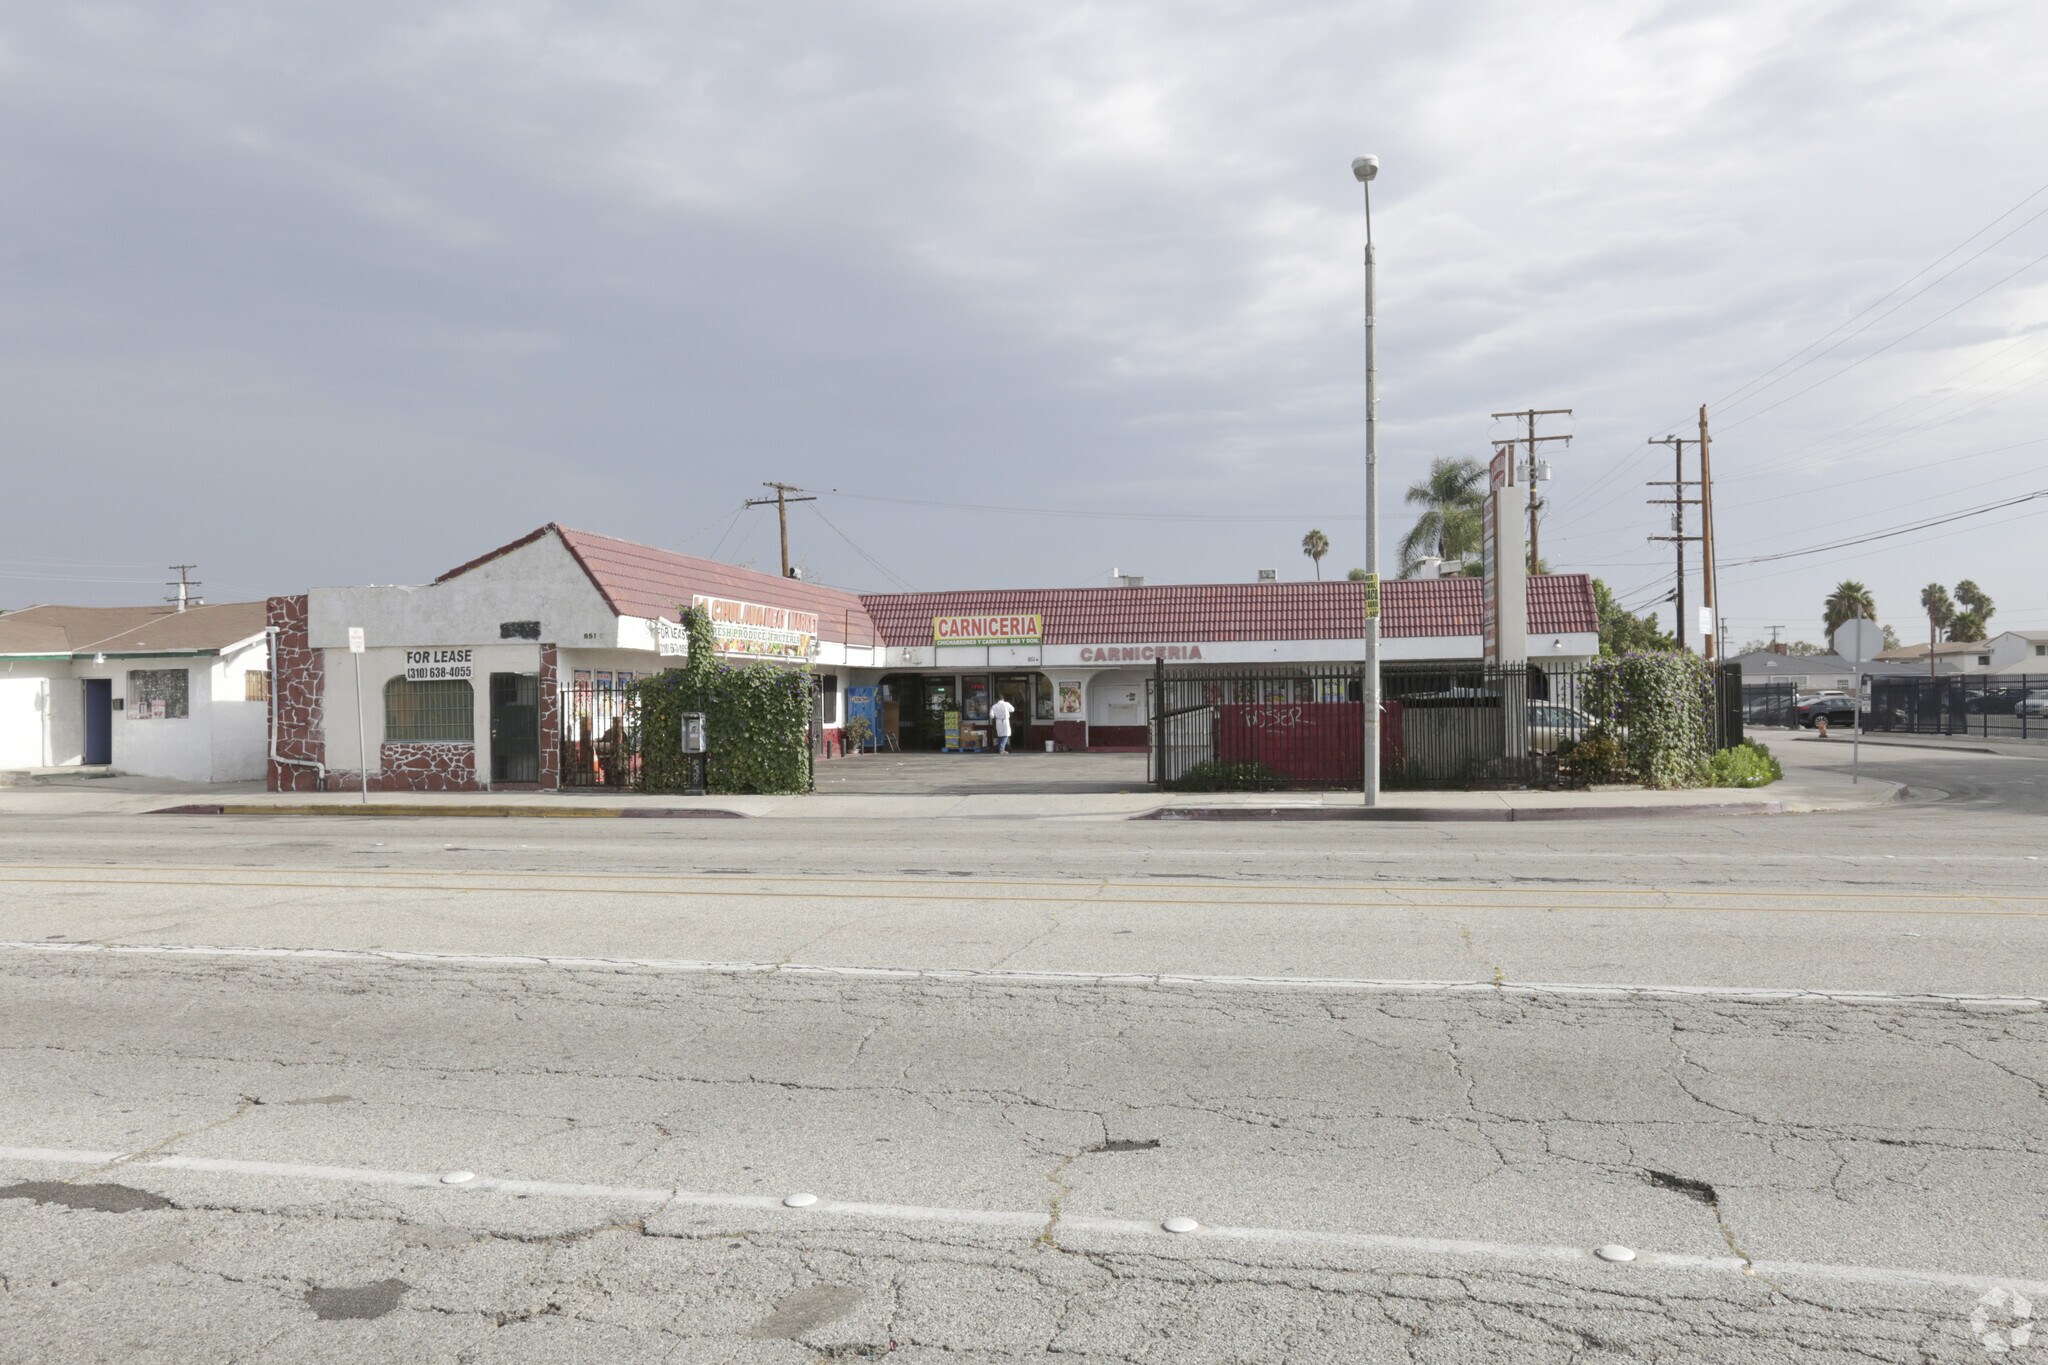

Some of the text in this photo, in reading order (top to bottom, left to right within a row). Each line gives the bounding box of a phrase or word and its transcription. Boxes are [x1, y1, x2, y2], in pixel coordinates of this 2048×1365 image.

[711, 599, 764, 626] CHULADA
[764, 607, 786, 629] MEAT
[788, 611, 818, 633] MARKET
[713, 626, 732, 638] RESH
[733, 628, 766, 641] PRODUCE
[938, 616, 1038, 638] CARNICERIA
[407, 649, 472, 664] FOR LEASE
[1080, 646, 1203, 662] CARNICERIA
[407, 666, 472, 679] (310) 638-4055
